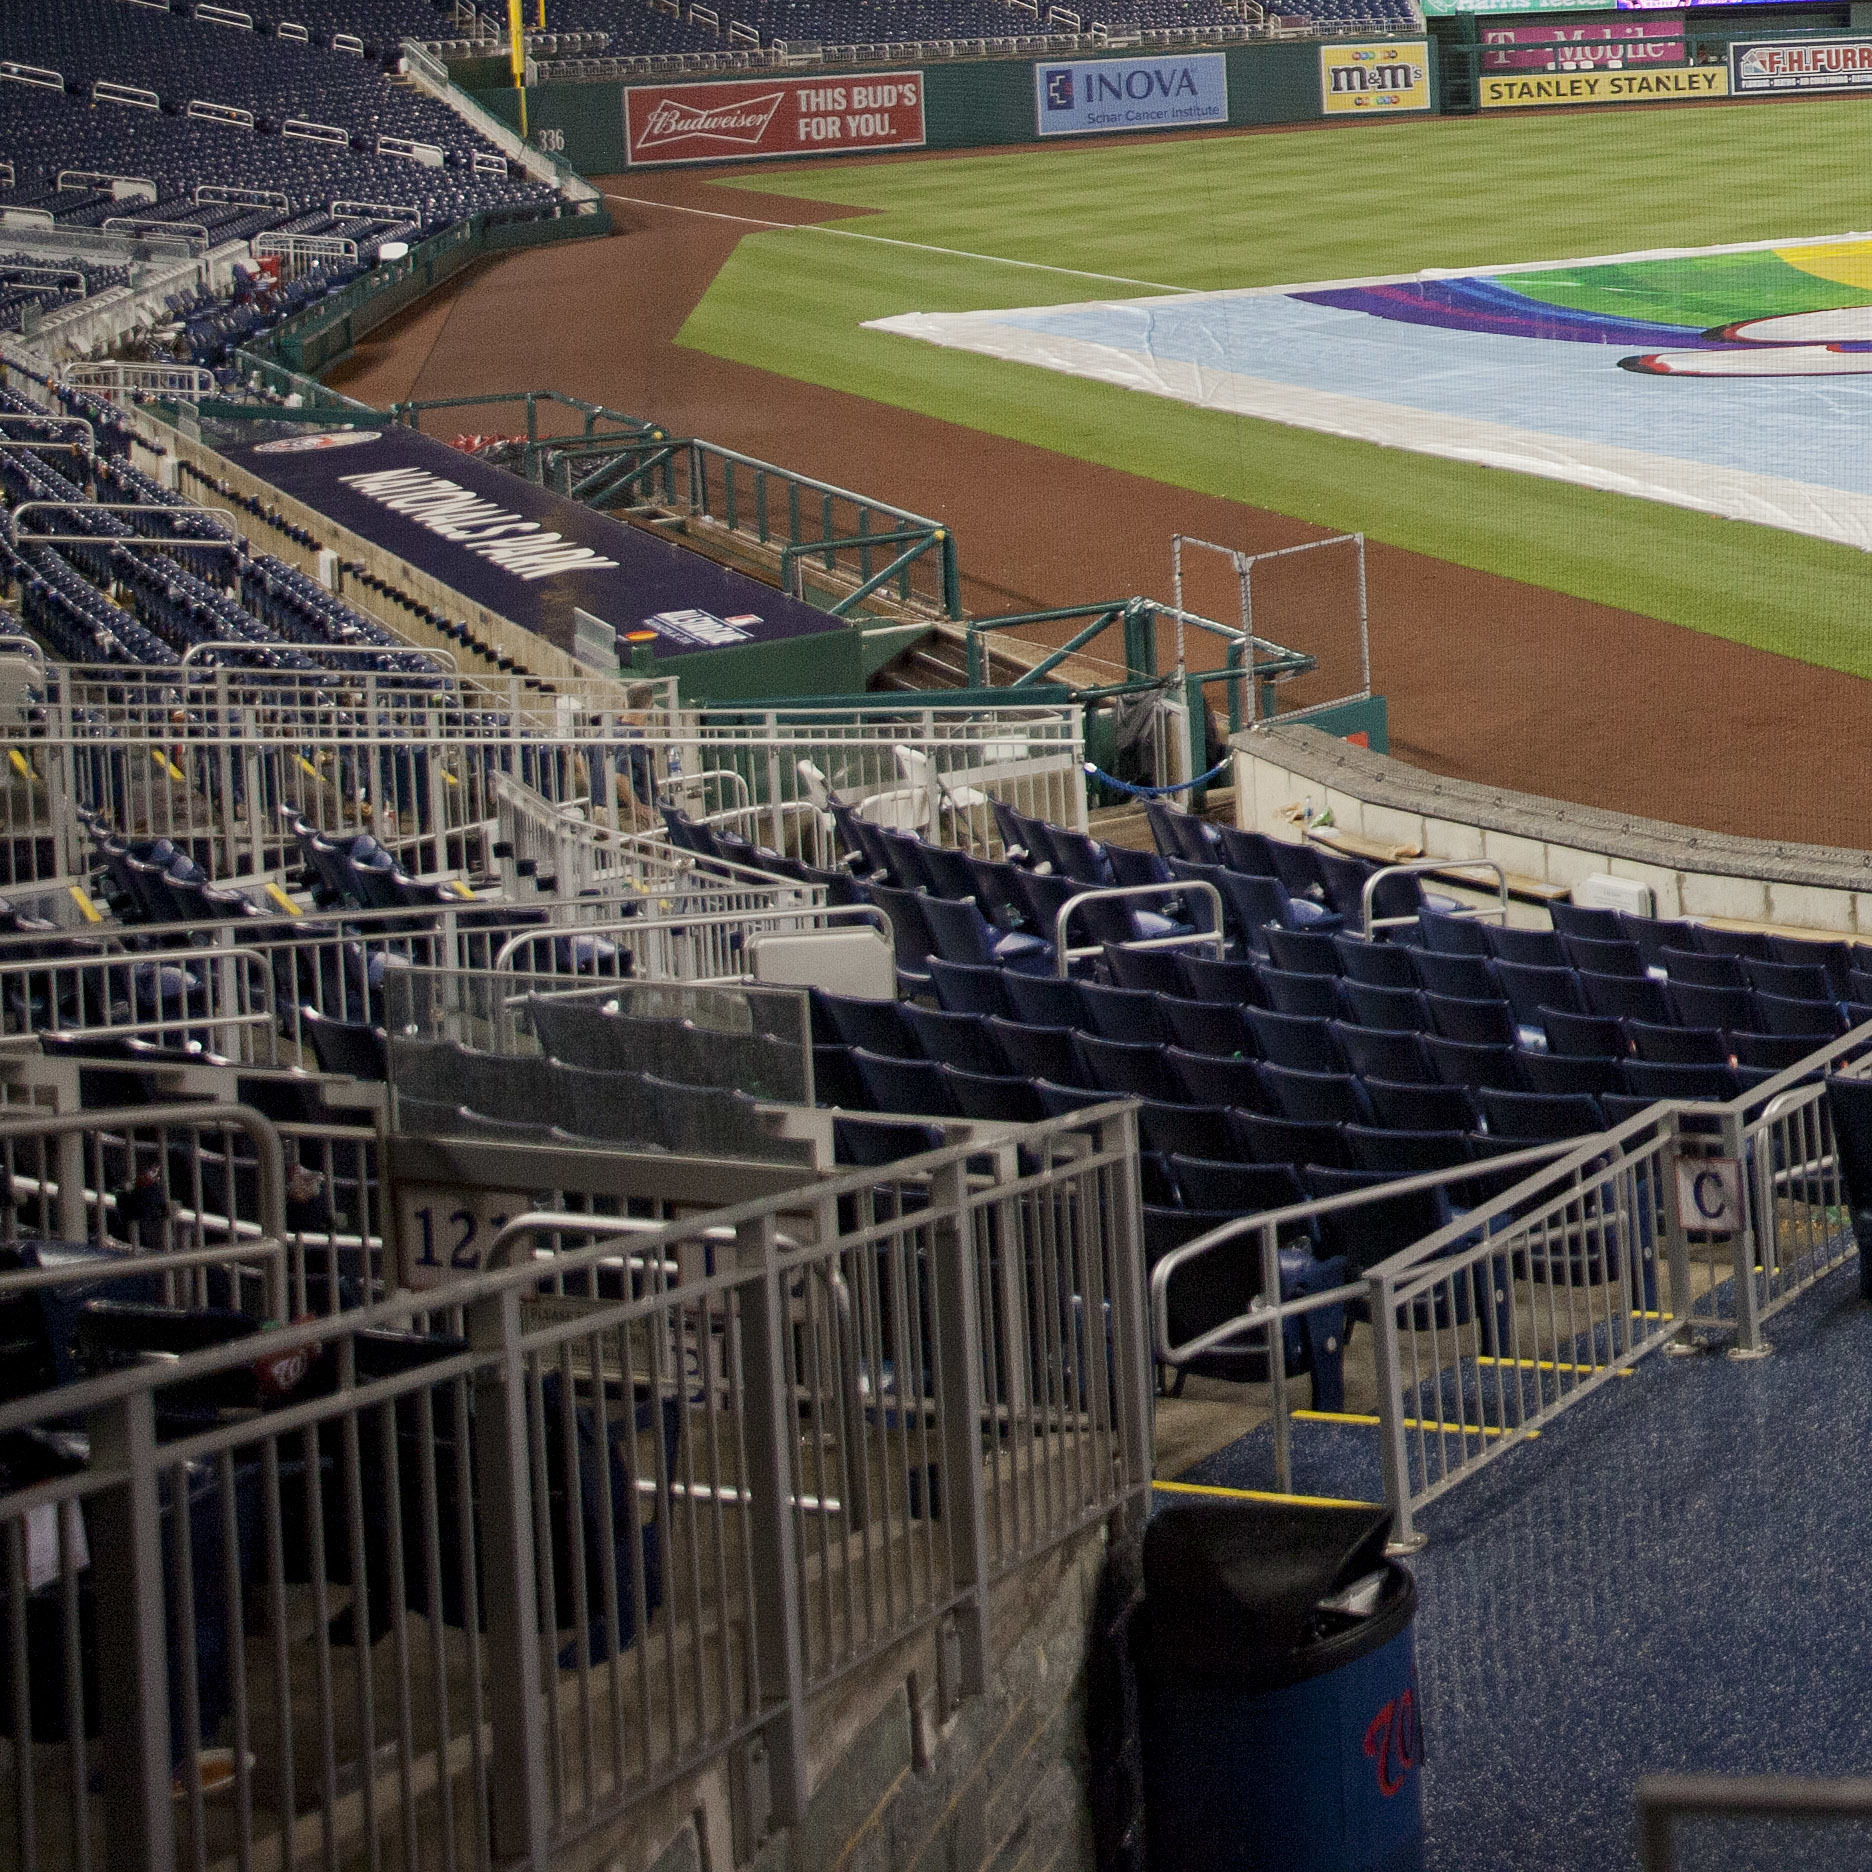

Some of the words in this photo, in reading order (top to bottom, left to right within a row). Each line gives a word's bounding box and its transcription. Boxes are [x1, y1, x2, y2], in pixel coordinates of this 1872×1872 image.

[797, 86, 858, 114] THIS
[861, 82, 918, 110] BUD'S
[1084, 67, 1198, 103] INOVA
[1489, 78, 1600, 101] STANLEY
[1611, 72, 1718, 96] STANLEY
[652, 106, 771, 136] Budweiser
[799, 116, 845, 143] FOR
[848, 112, 897, 140] YOU.
[1126, 107, 1168, 124] Cancer
[1171, 104, 1221, 122] Institute
[539, 128, 565, 150] 336
[338, 467, 541, 545] NATIONALS
[468, 530, 620, 581] PARK
[1692, 1170, 1726, 1219] C
[414, 1206, 510, 1270] 12
